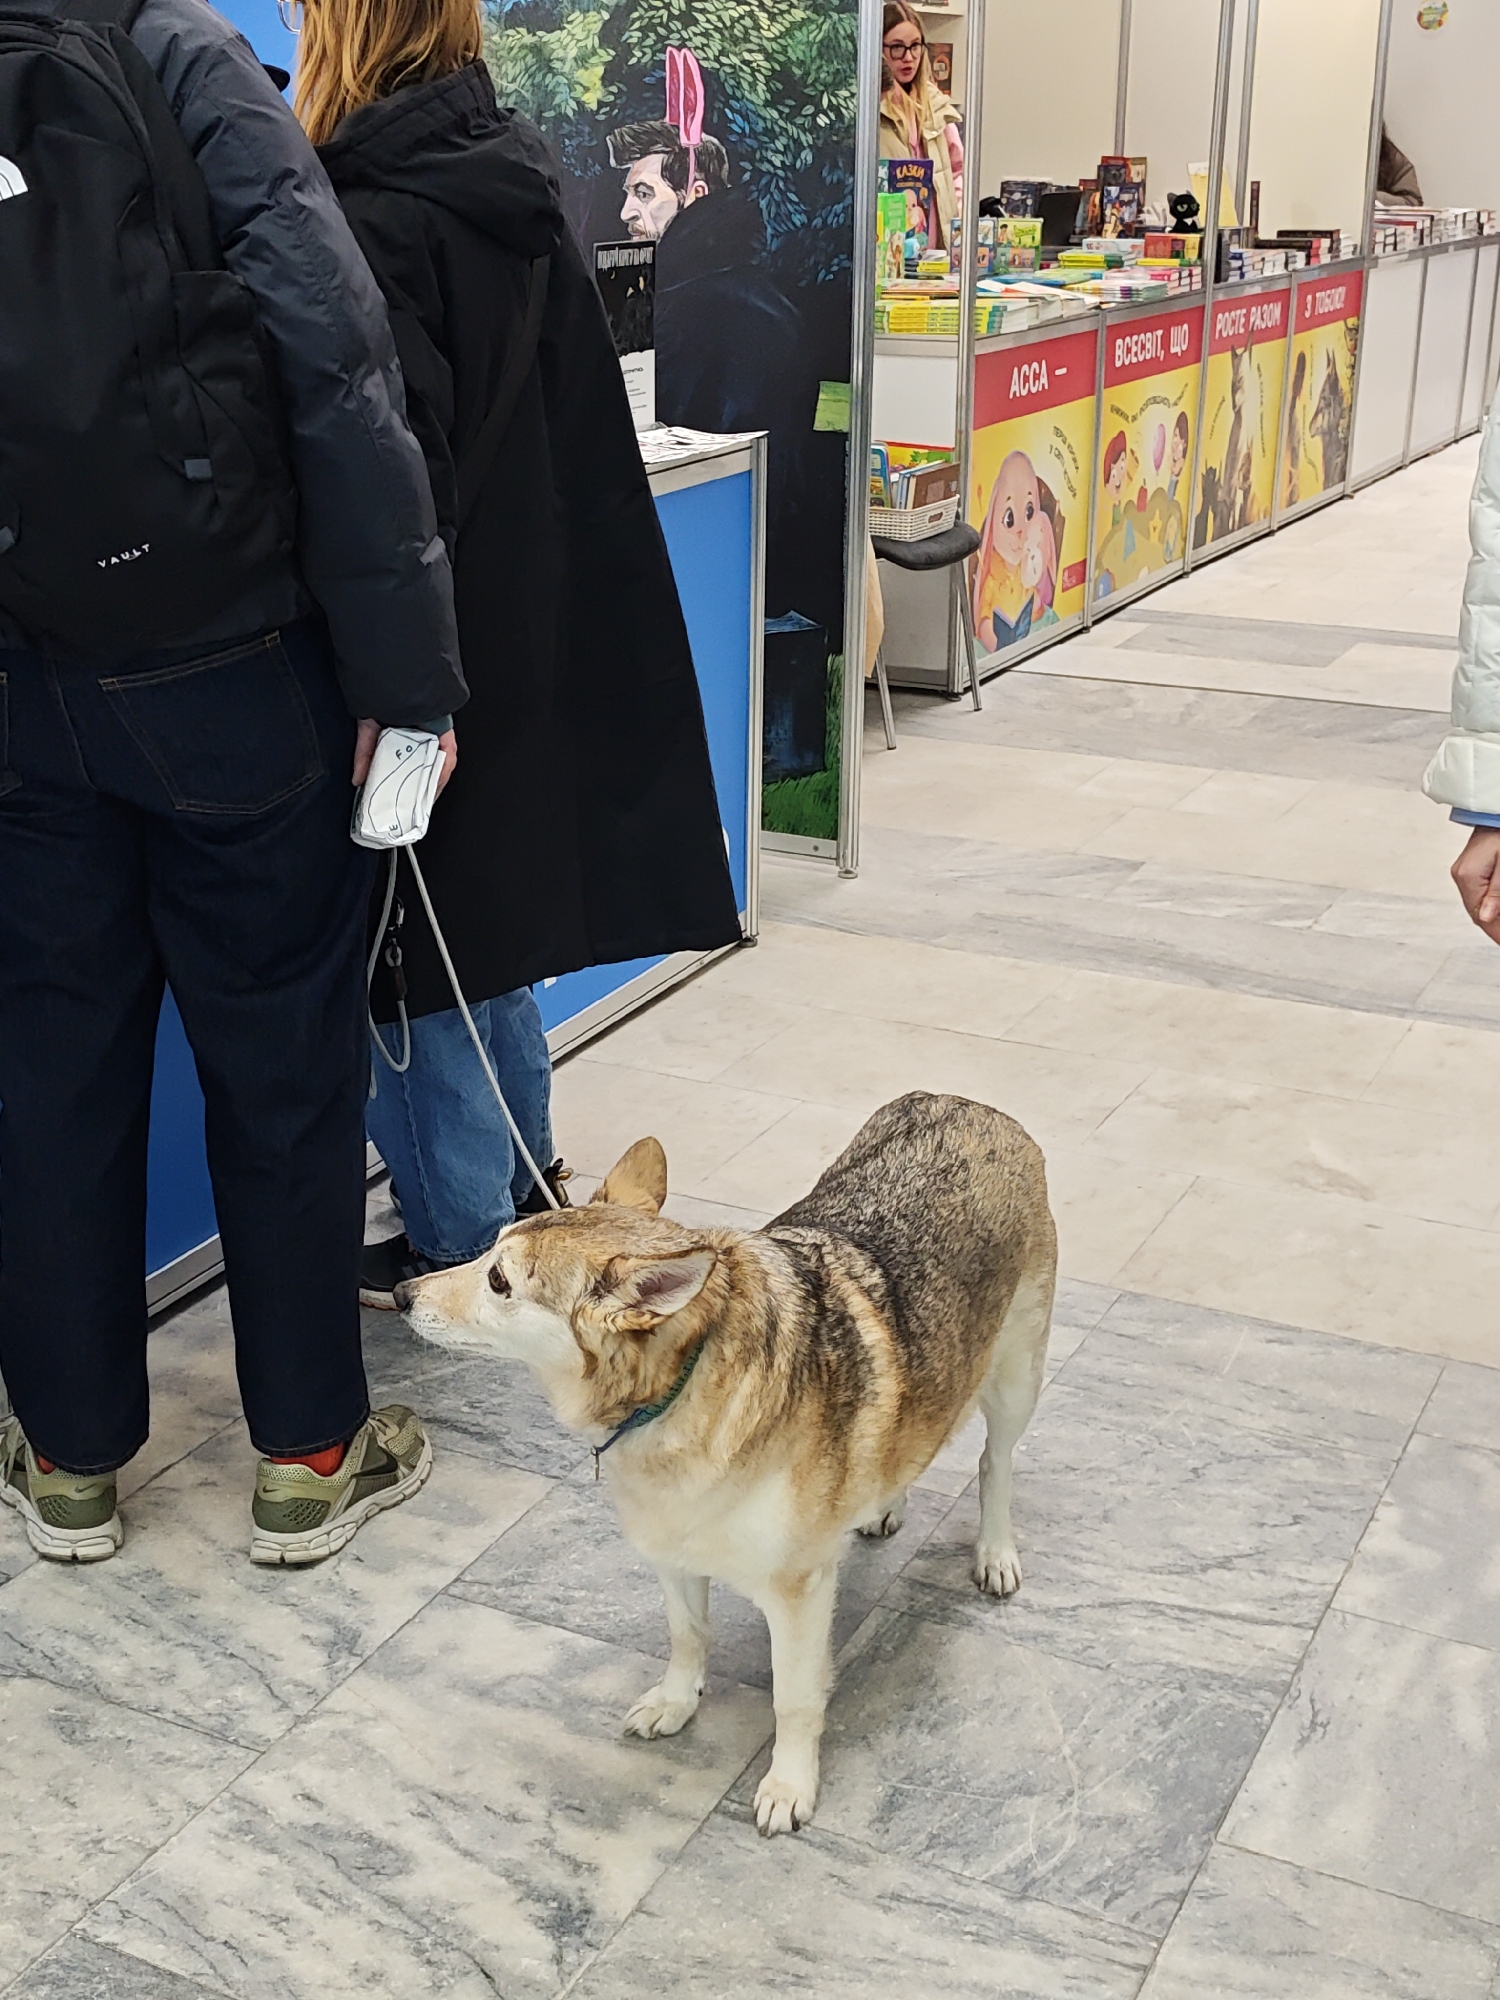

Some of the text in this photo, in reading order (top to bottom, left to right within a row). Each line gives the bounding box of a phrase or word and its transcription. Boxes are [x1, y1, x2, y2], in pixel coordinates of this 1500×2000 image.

[896, 164, 925, 180] КАЗКИ
[1215, 302, 1282, 340] РОСТЕ РАЗОМ
[1115, 323, 1189, 368] ВСЕСВІТ, ЩО
[1009, 359, 1049, 399] АССА
[97, 543, 150, 568] VAULT
